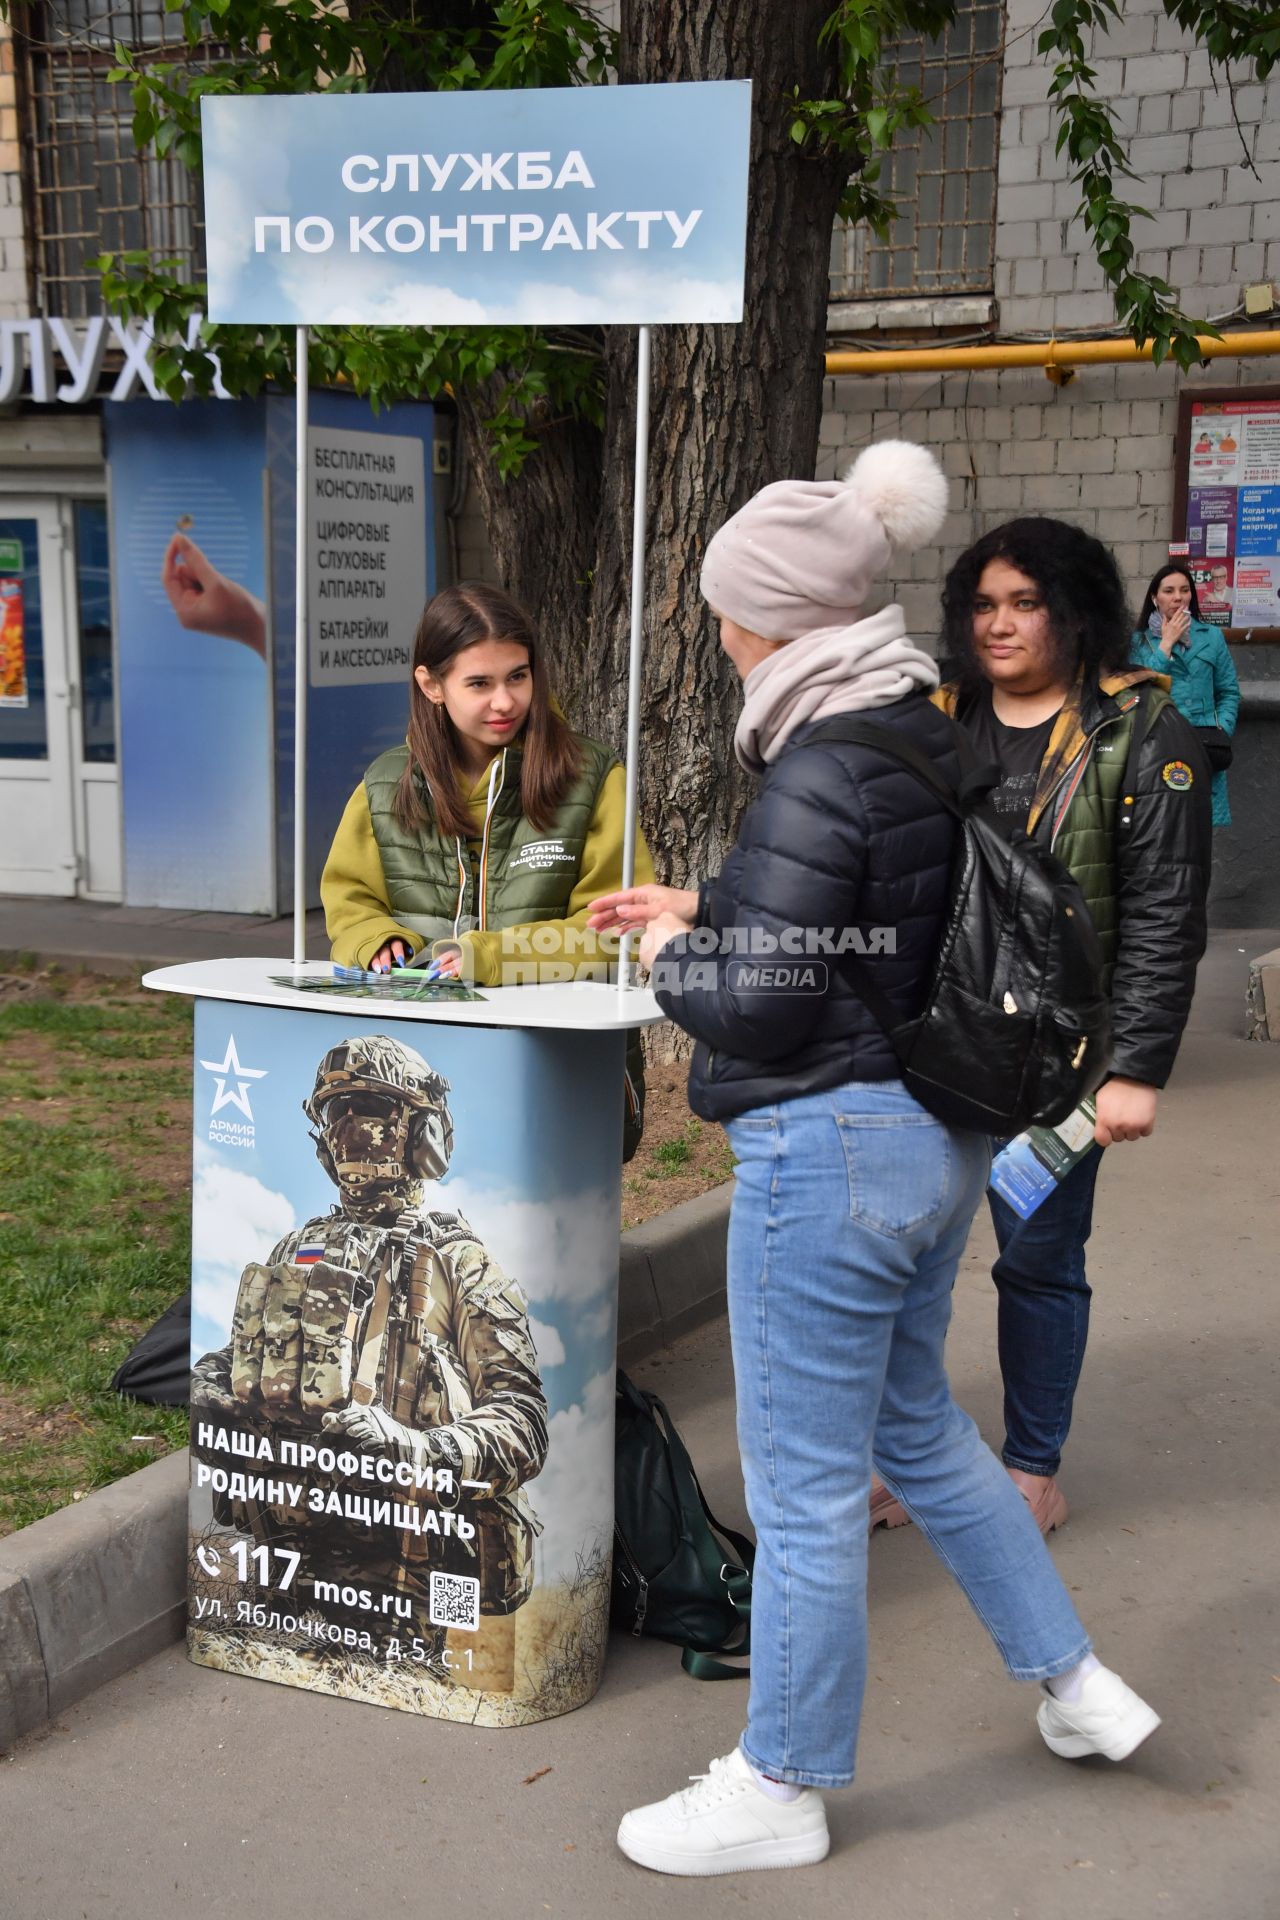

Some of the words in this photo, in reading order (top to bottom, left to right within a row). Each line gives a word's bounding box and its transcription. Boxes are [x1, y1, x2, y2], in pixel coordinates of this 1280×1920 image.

[340, 150, 595, 193] СЛУЖБА
[254, 216, 335, 254] ПО
[349, 209, 703, 253] КОНТРАКТУ
[315, 447, 396, 474] БЕСПЛАТНАЯ
[316, 478, 415, 505] КОНСУЛЬТАЦИЯ
[1243, 507, 1265, 515] Когда
[316, 520, 390, 543] ЦИФРОВЫЕ
[1242, 523, 1277, 532] квартира
[317, 550, 386, 571] СЛУХОВЫЕ
[318, 579, 386, 599] АППАРАТЫ
[319, 617, 389, 640] БАТАРЕЙКИ
[320, 650, 330, 668] И
[332, 648, 410, 667] АКСЕССУАРЫ
[510, 854, 576, 867] ЗАЩИТНИКОМ
[520, 845, 564, 856] СТАНЬ
[208, 1132, 255, 1147] РОССИИ
[209, 1120, 255, 1136] АРМИЯ
[198, 1423, 274, 1462] НАША
[280, 1440, 453, 1493] ПРОФЕССИЯ
[197, 1463, 303, 1506] РОДИНУ
[308, 1488, 475, 1540] ЗАЩИЩАТЬ
[229, 1540, 301, 1590] 117
[314, 1579, 412, 1619] mos.ru
[195, 1595, 228, 1619] ул.
[236, 1600, 377, 1653] Яблочкова,
[386, 1637, 431, 1667] д.5,
[441, 1648, 474, 1671] с.1
